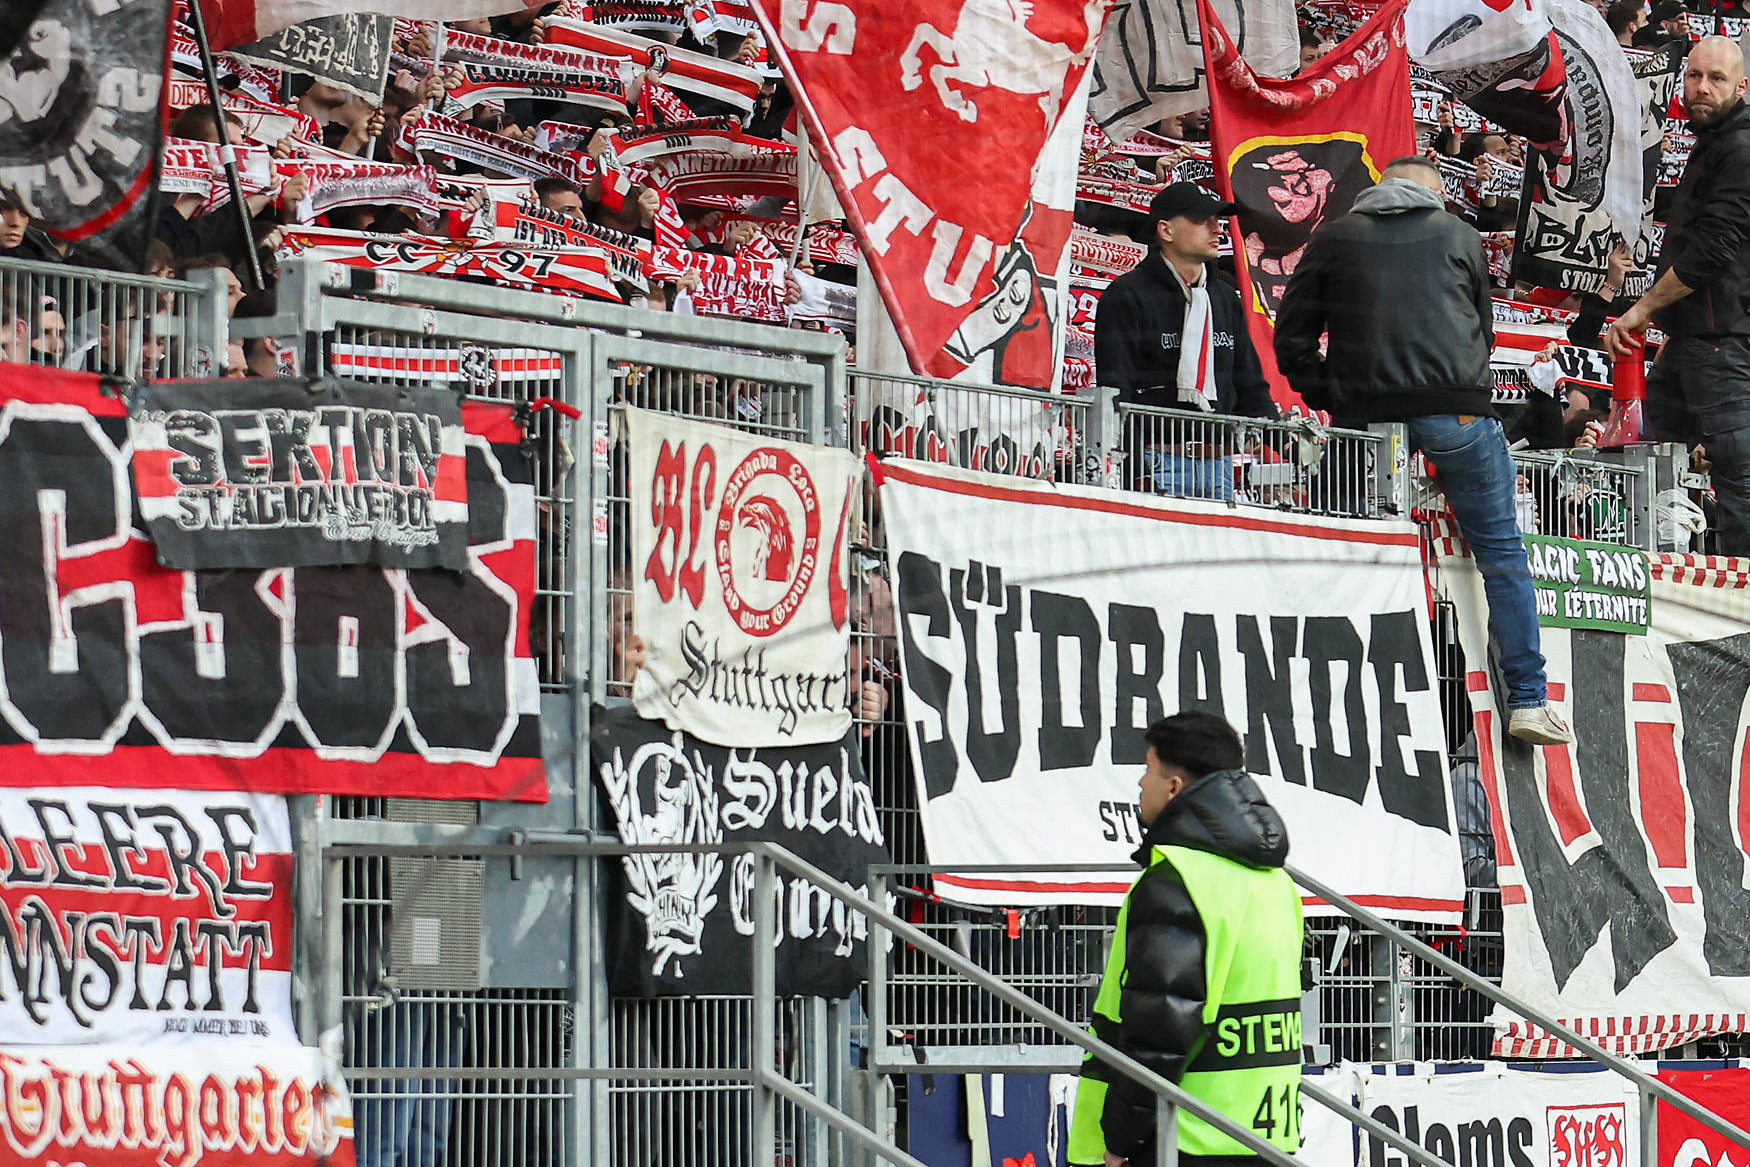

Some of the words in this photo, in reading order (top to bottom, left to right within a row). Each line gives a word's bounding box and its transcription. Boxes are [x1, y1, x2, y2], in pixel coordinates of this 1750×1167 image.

[498, 249, 557, 276] 97
[169, 405, 442, 487] SEKTION
[1584, 549, 1647, 591] FANS
[898, 550, 1453, 836] SÜDBANDE
